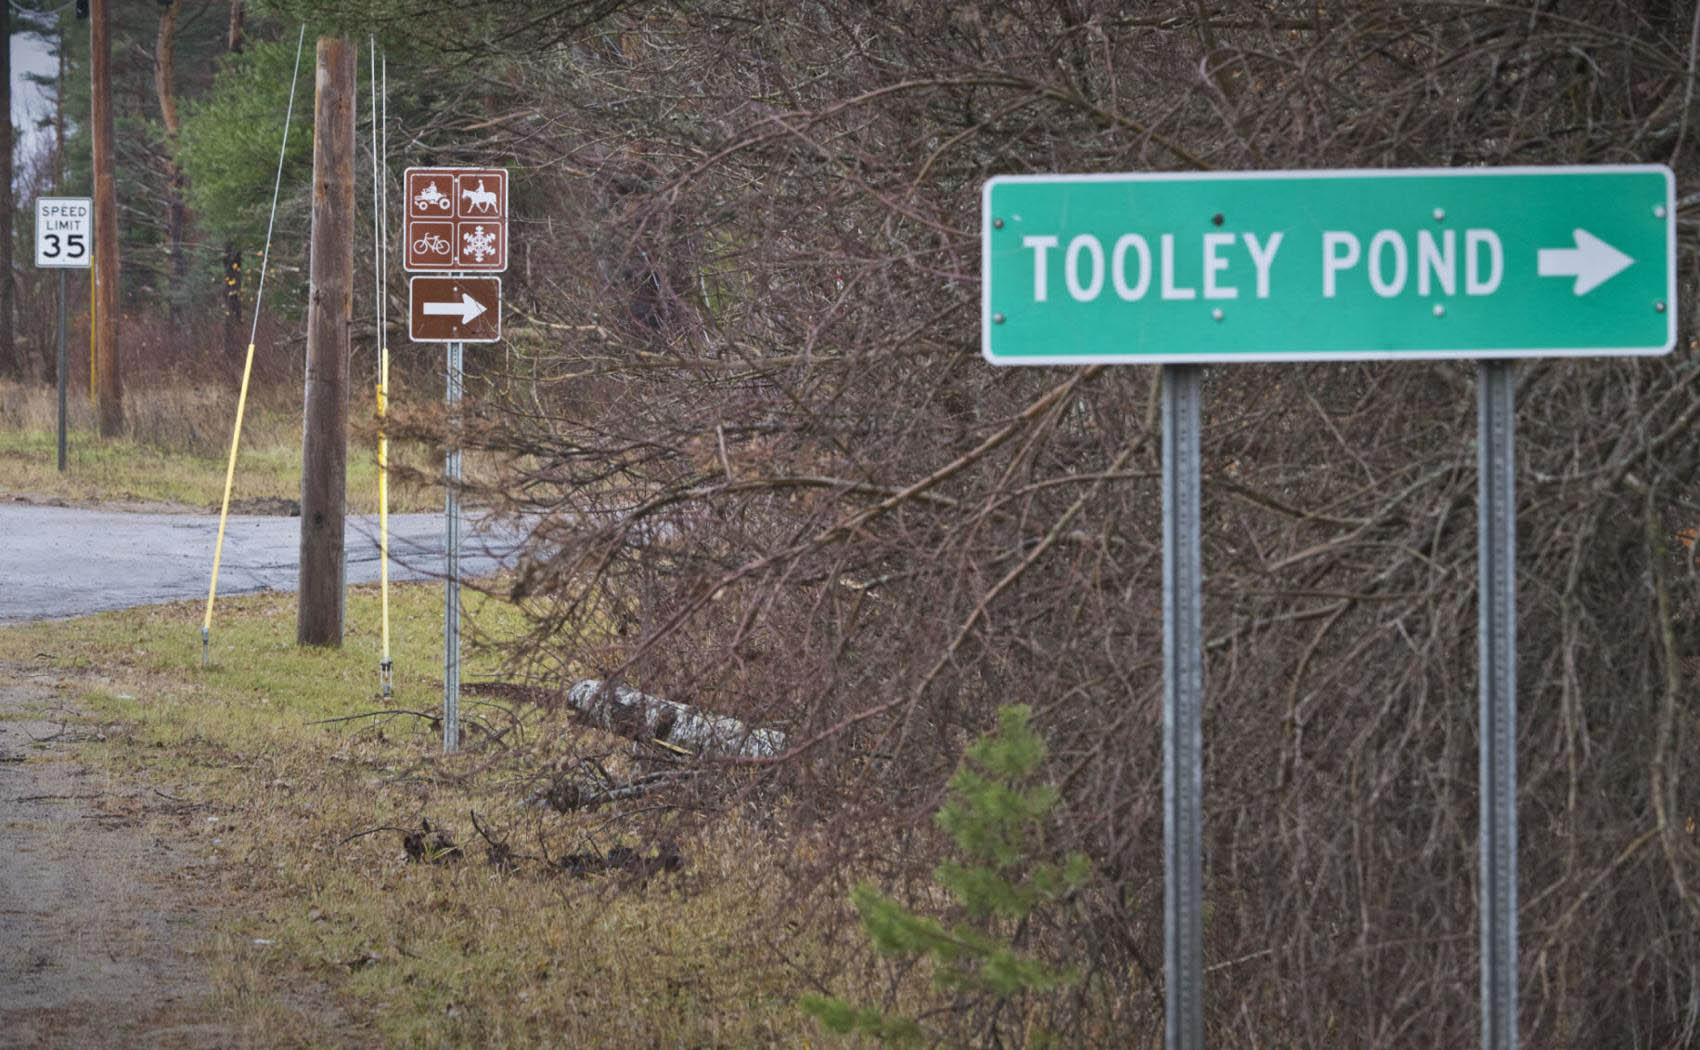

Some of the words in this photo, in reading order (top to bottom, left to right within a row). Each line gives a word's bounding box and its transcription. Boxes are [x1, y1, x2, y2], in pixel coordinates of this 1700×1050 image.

[42, 206, 87, 217] SPEED
[46, 220, 81, 231] LIMIT
[43, 234, 85, 258] 35
[1023, 232, 1284, 302] TOOLEY
[1323, 229, 1504, 298] POND
